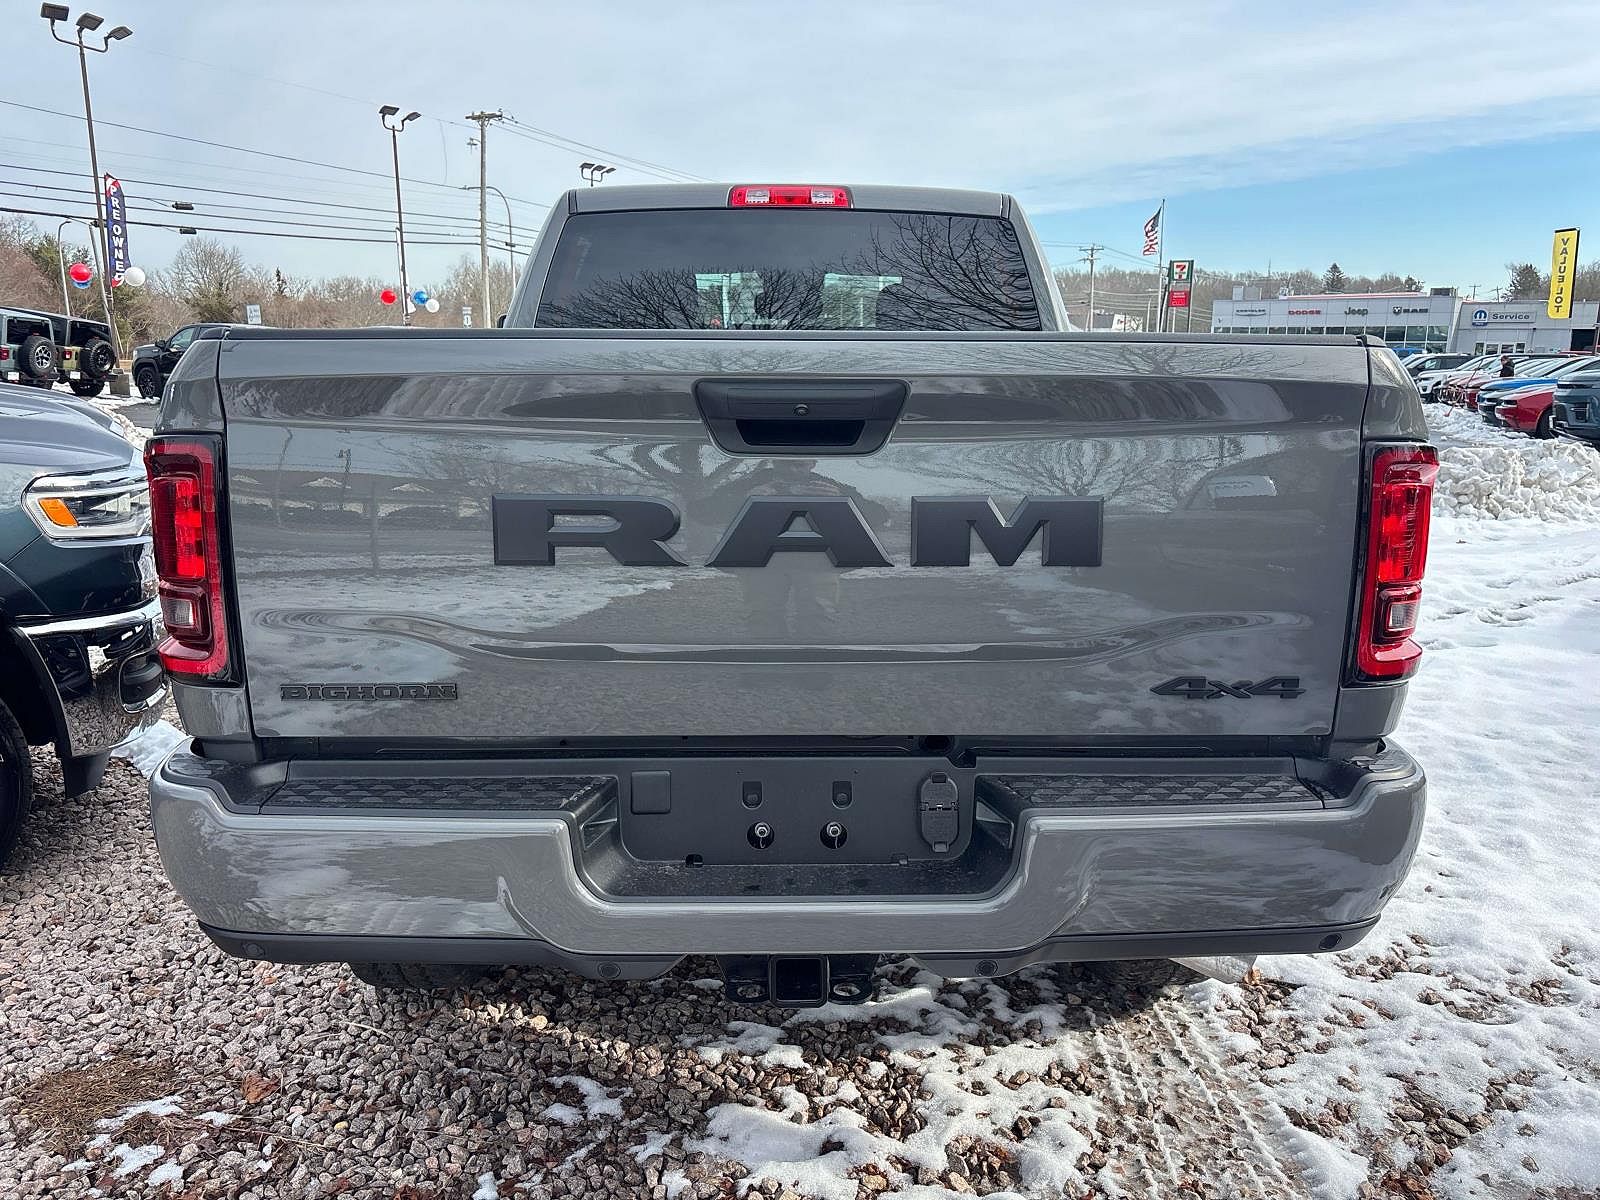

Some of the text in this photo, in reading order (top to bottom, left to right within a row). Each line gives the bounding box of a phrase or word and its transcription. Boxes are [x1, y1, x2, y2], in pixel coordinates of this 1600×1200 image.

[110, 184, 120, 221] PRE
[1344, 306, 1369, 317] Jeep
[492, 495, 1105, 567] RAM
[280, 683, 458, 701] BIGHORN
